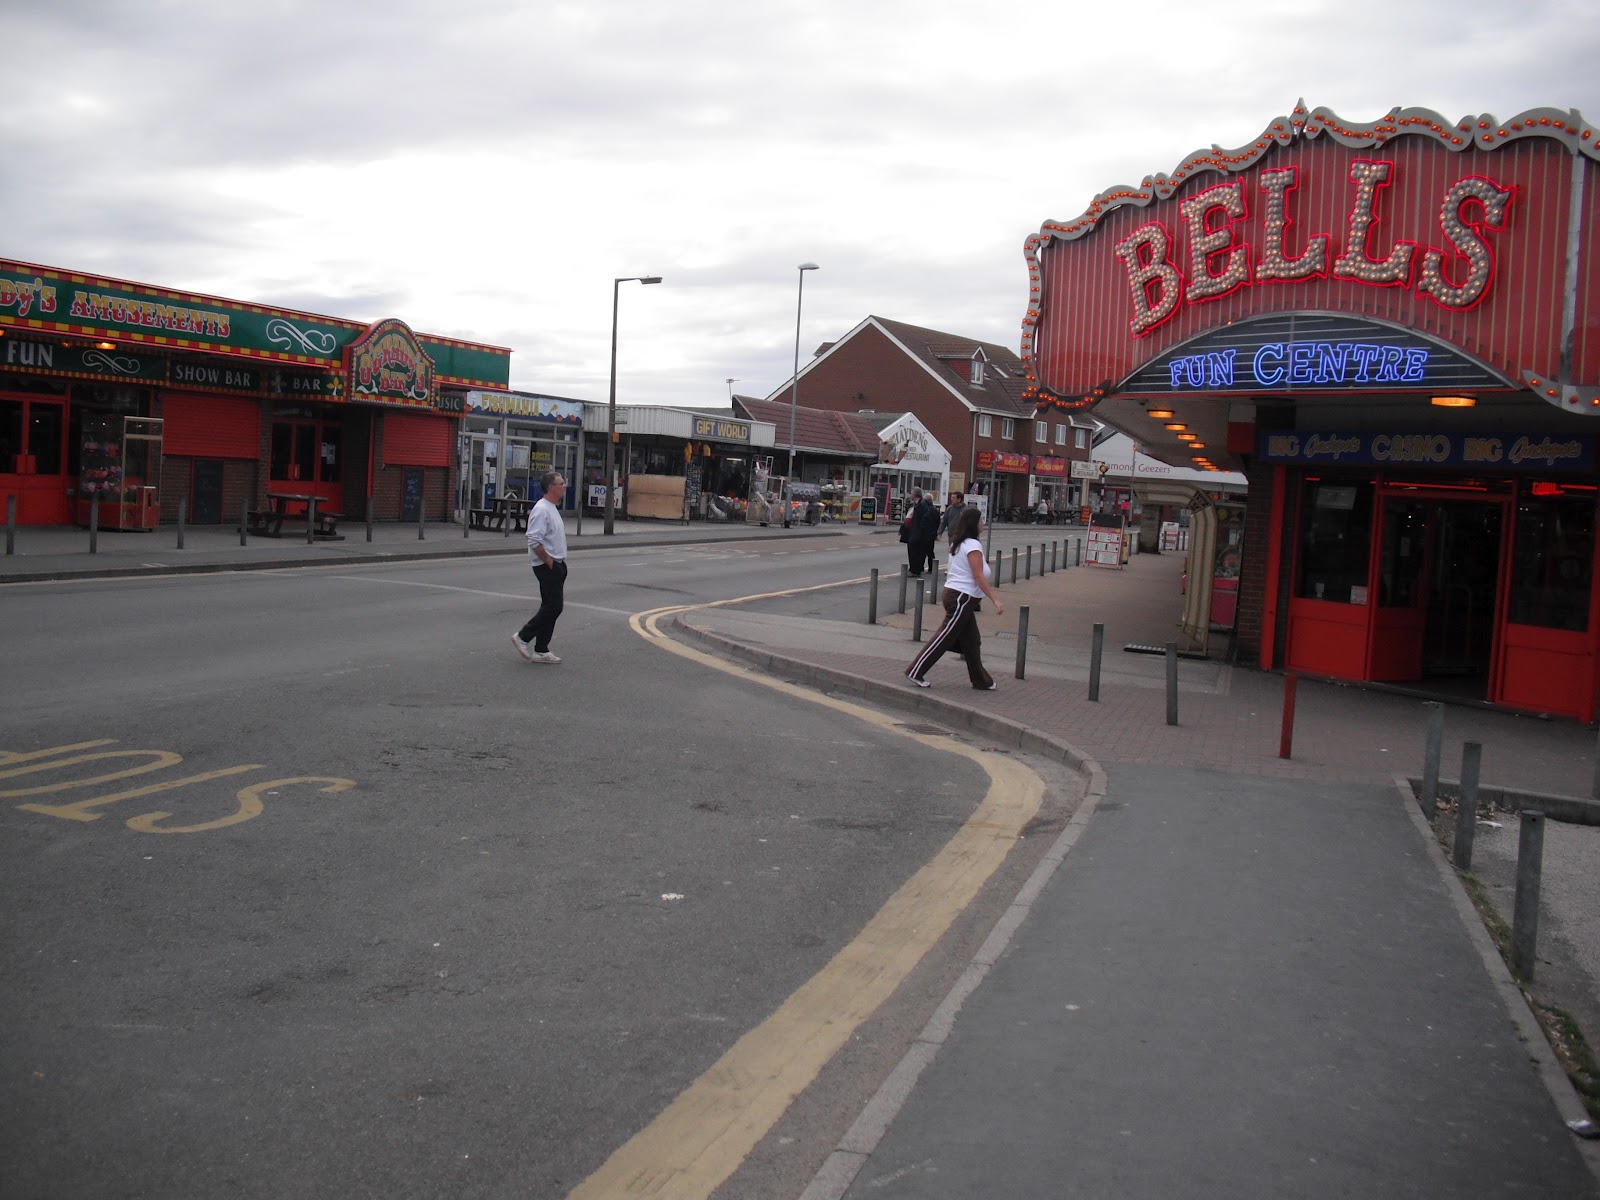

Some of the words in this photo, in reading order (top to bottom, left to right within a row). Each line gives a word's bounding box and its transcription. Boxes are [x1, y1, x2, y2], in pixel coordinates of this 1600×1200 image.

[1116, 158, 1520, 339] BELLS
[0, 278, 57, 317] DY'S
[70, 290, 231, 338] AMUSEMENTS
[7, 340, 54, 368] FUN
[1169, 348, 1237, 388] FUN
[1252, 342, 1429, 387] CENTRE
[175, 364, 220, 383] SHOW
[225, 366, 252, 387] BAR
[292, 378, 321, 391] BAR
[379, 369, 409, 397] BAR
[438, 397, 460, 411] USIC
[481, 394, 540, 417] FISHMANIA
[696, 419, 717, 435] GIFT
[717, 422, 748, 439] WORLD
[1268, 435, 1300, 457] BIG
[1371, 434, 1451, 462] CASINO
[1463, 437, 1503, 462] BIG
[1106, 461, 1136, 472] amond
[1138, 463, 1171, 474] Geezers
